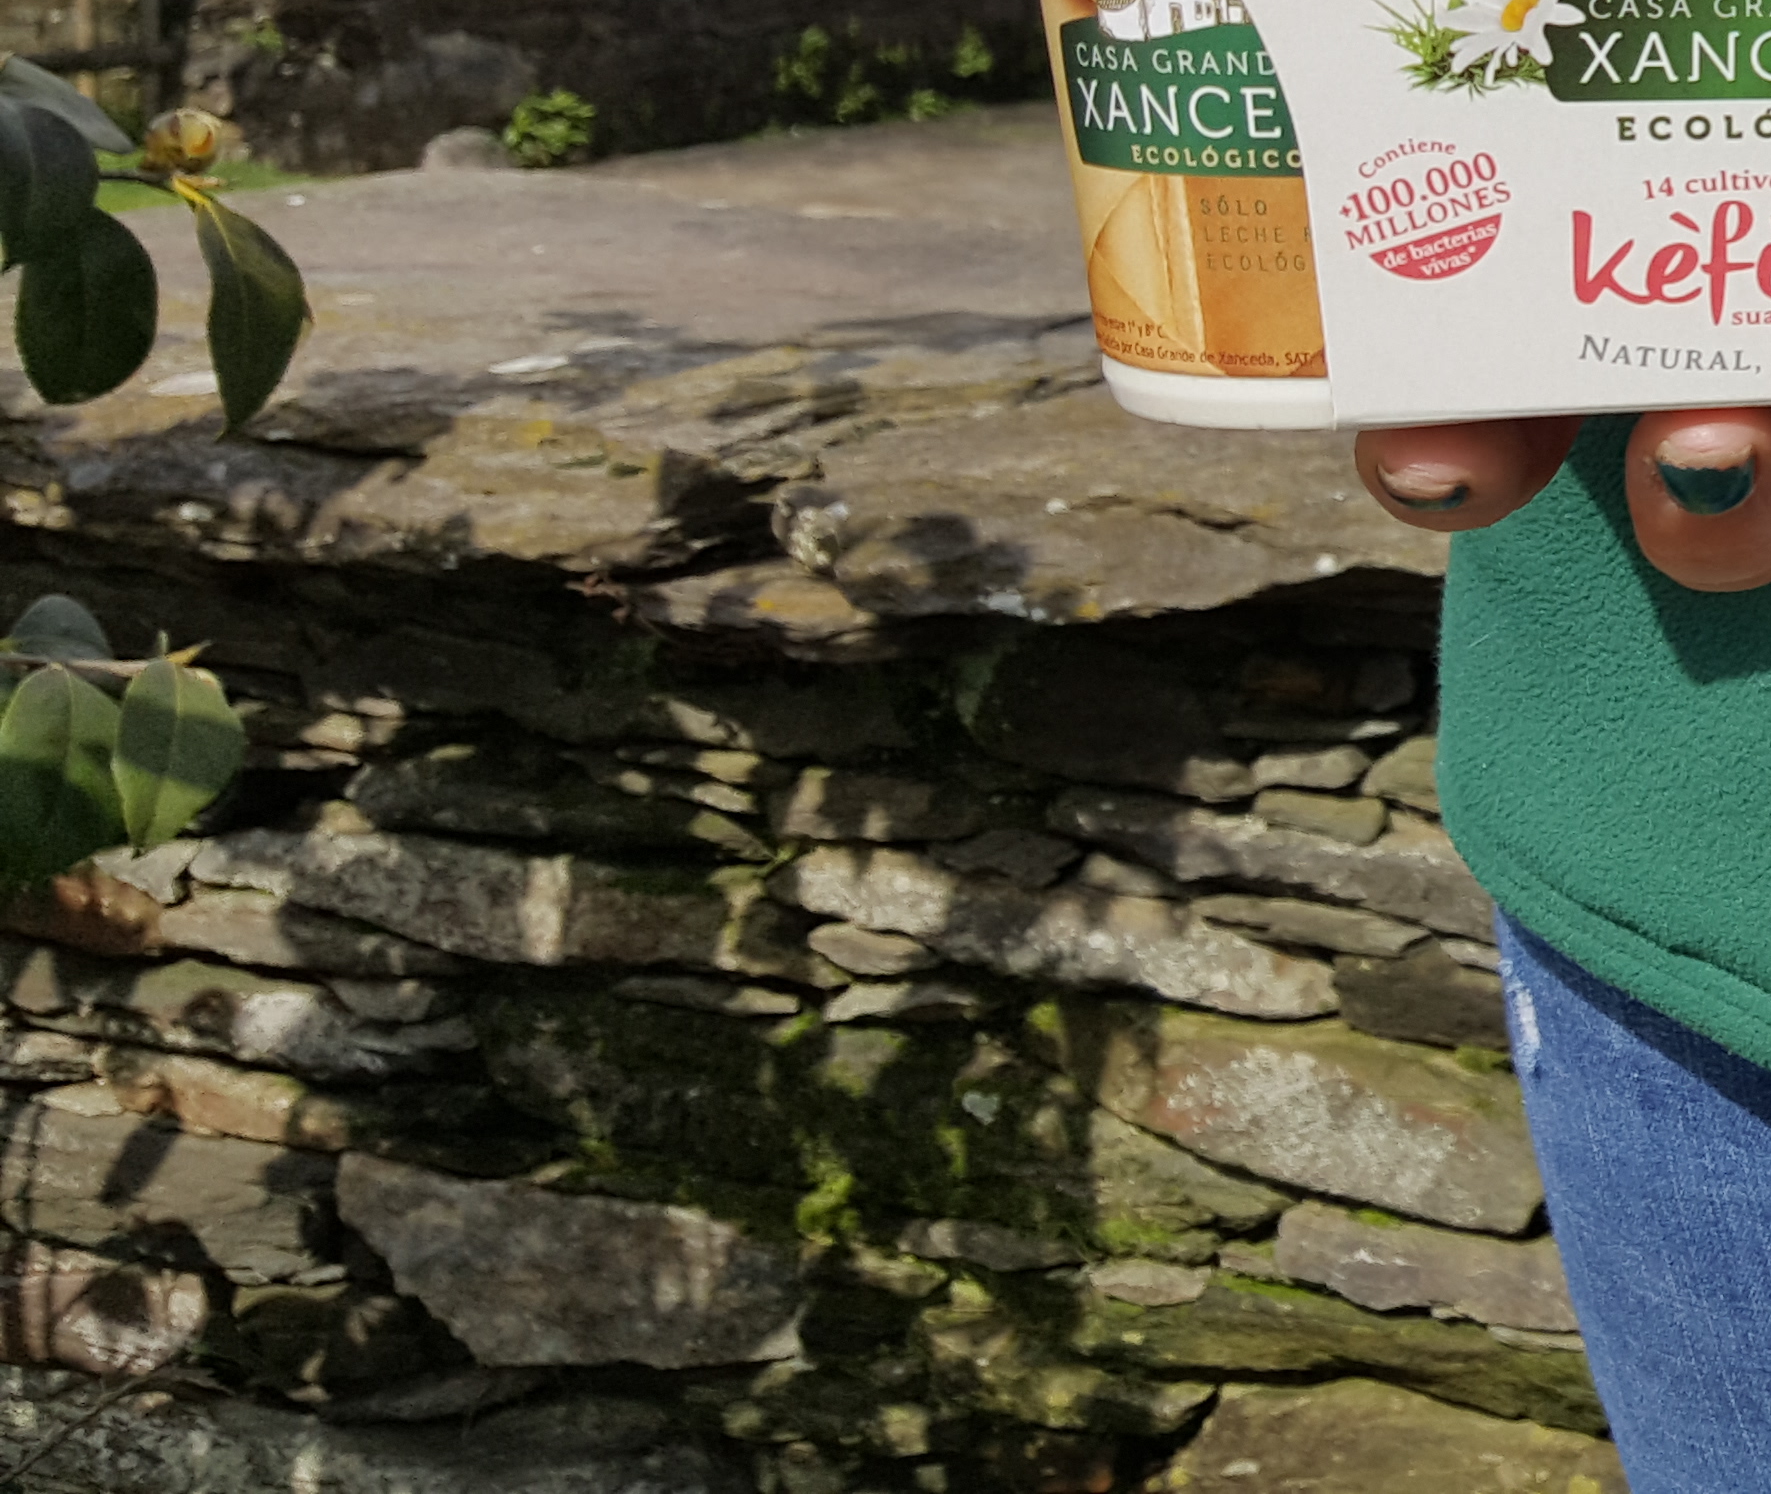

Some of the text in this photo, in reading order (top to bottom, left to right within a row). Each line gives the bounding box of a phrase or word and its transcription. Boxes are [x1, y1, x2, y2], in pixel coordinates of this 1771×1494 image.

[1076, 42, 1138, 72] CASA
[1077, 77, 1282, 139] XANCE
[1358, 138, 1457, 179] Contiene
[1642, 177, 1674, 200] 14
[1200, 195, 1267, 216] SÓLO
[1345, 182, 1512, 250] MILLONES
[1204, 226, 1285, 243] LECHE
[1383, 223, 1498, 269] de bacterias
[1135, 342, 1155, 359] Casa
[1157, 346, 1195, 363] Grande
[1200, 351, 1216, 365] de
